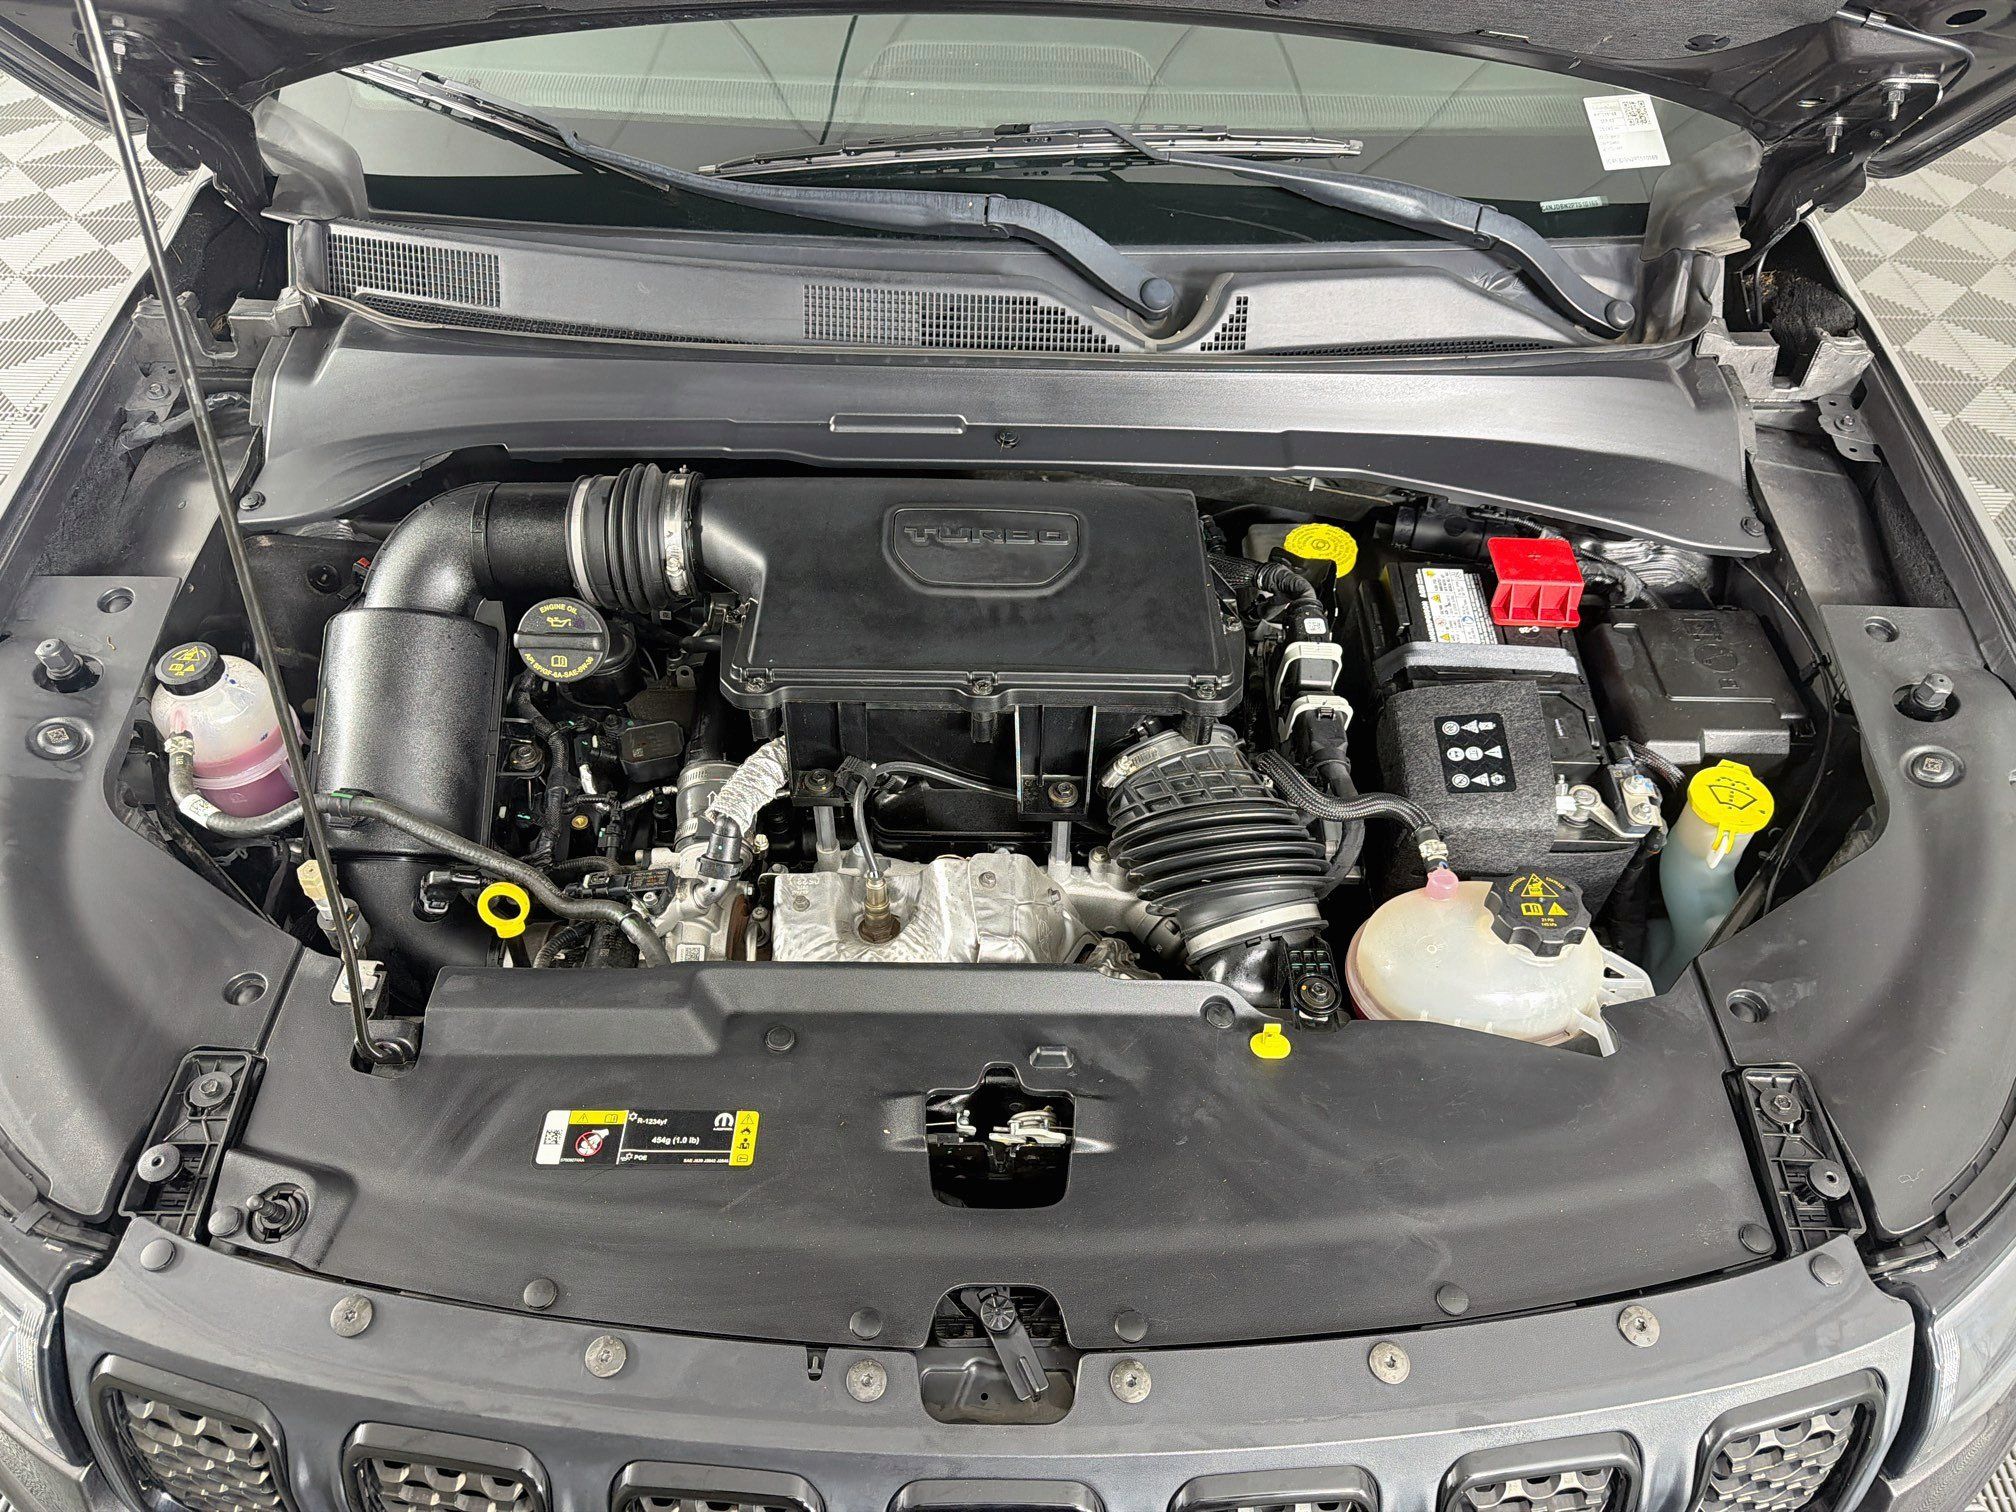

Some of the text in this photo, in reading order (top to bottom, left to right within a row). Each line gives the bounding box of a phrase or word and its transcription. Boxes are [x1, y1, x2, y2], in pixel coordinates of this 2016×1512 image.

[904, 526, 1071, 546] TURBO
[539, 603, 578, 615] ENGINE OIL
[524, 653, 536, 664] API
[637, 1117, 668, 1126] R-1234yf
[651, 1136, 700, 1145] 454g (1.0 lb)
